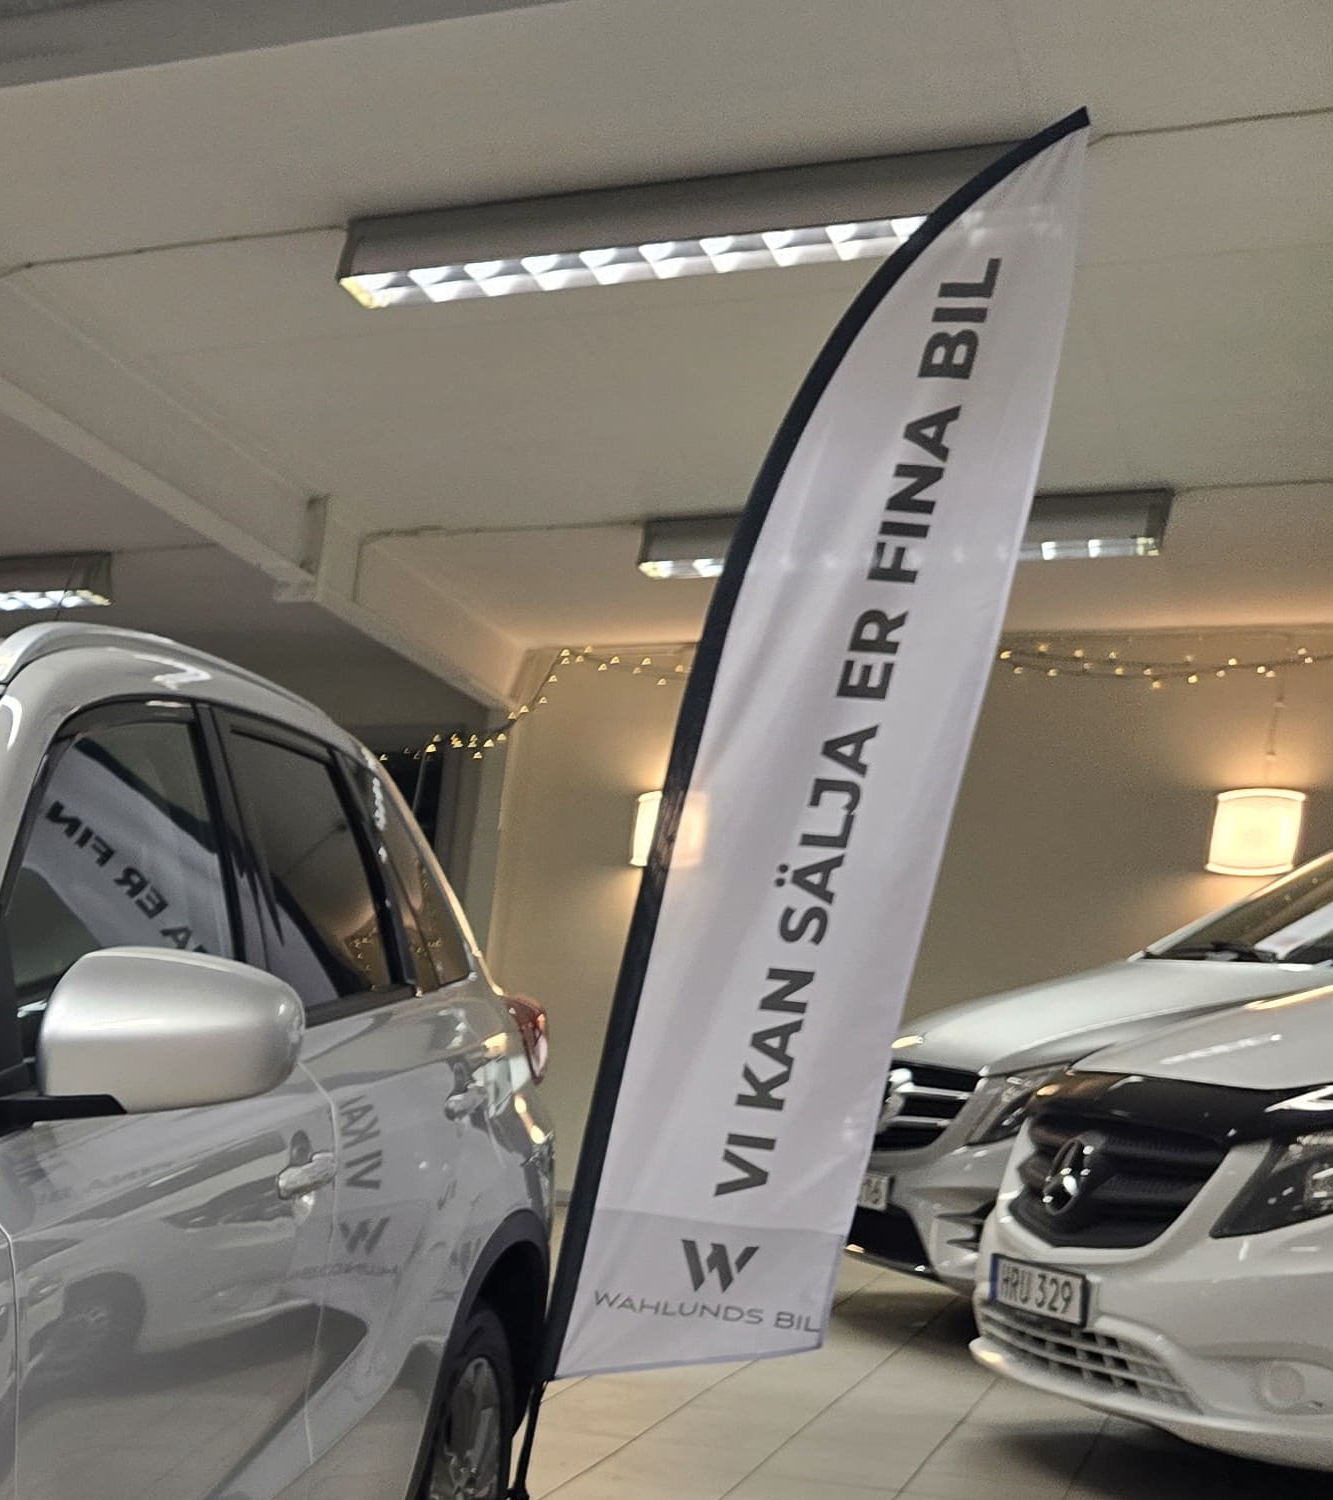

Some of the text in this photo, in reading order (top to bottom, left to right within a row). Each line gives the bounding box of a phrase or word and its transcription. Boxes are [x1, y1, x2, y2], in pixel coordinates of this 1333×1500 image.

[713, 257, 1001, 1197] VI KAN SÄLJA ER FINA BIL
[594, 1289, 823, 1333] WAHLUNDS BIL
[1034, 1273, 1073, 1314] 329
